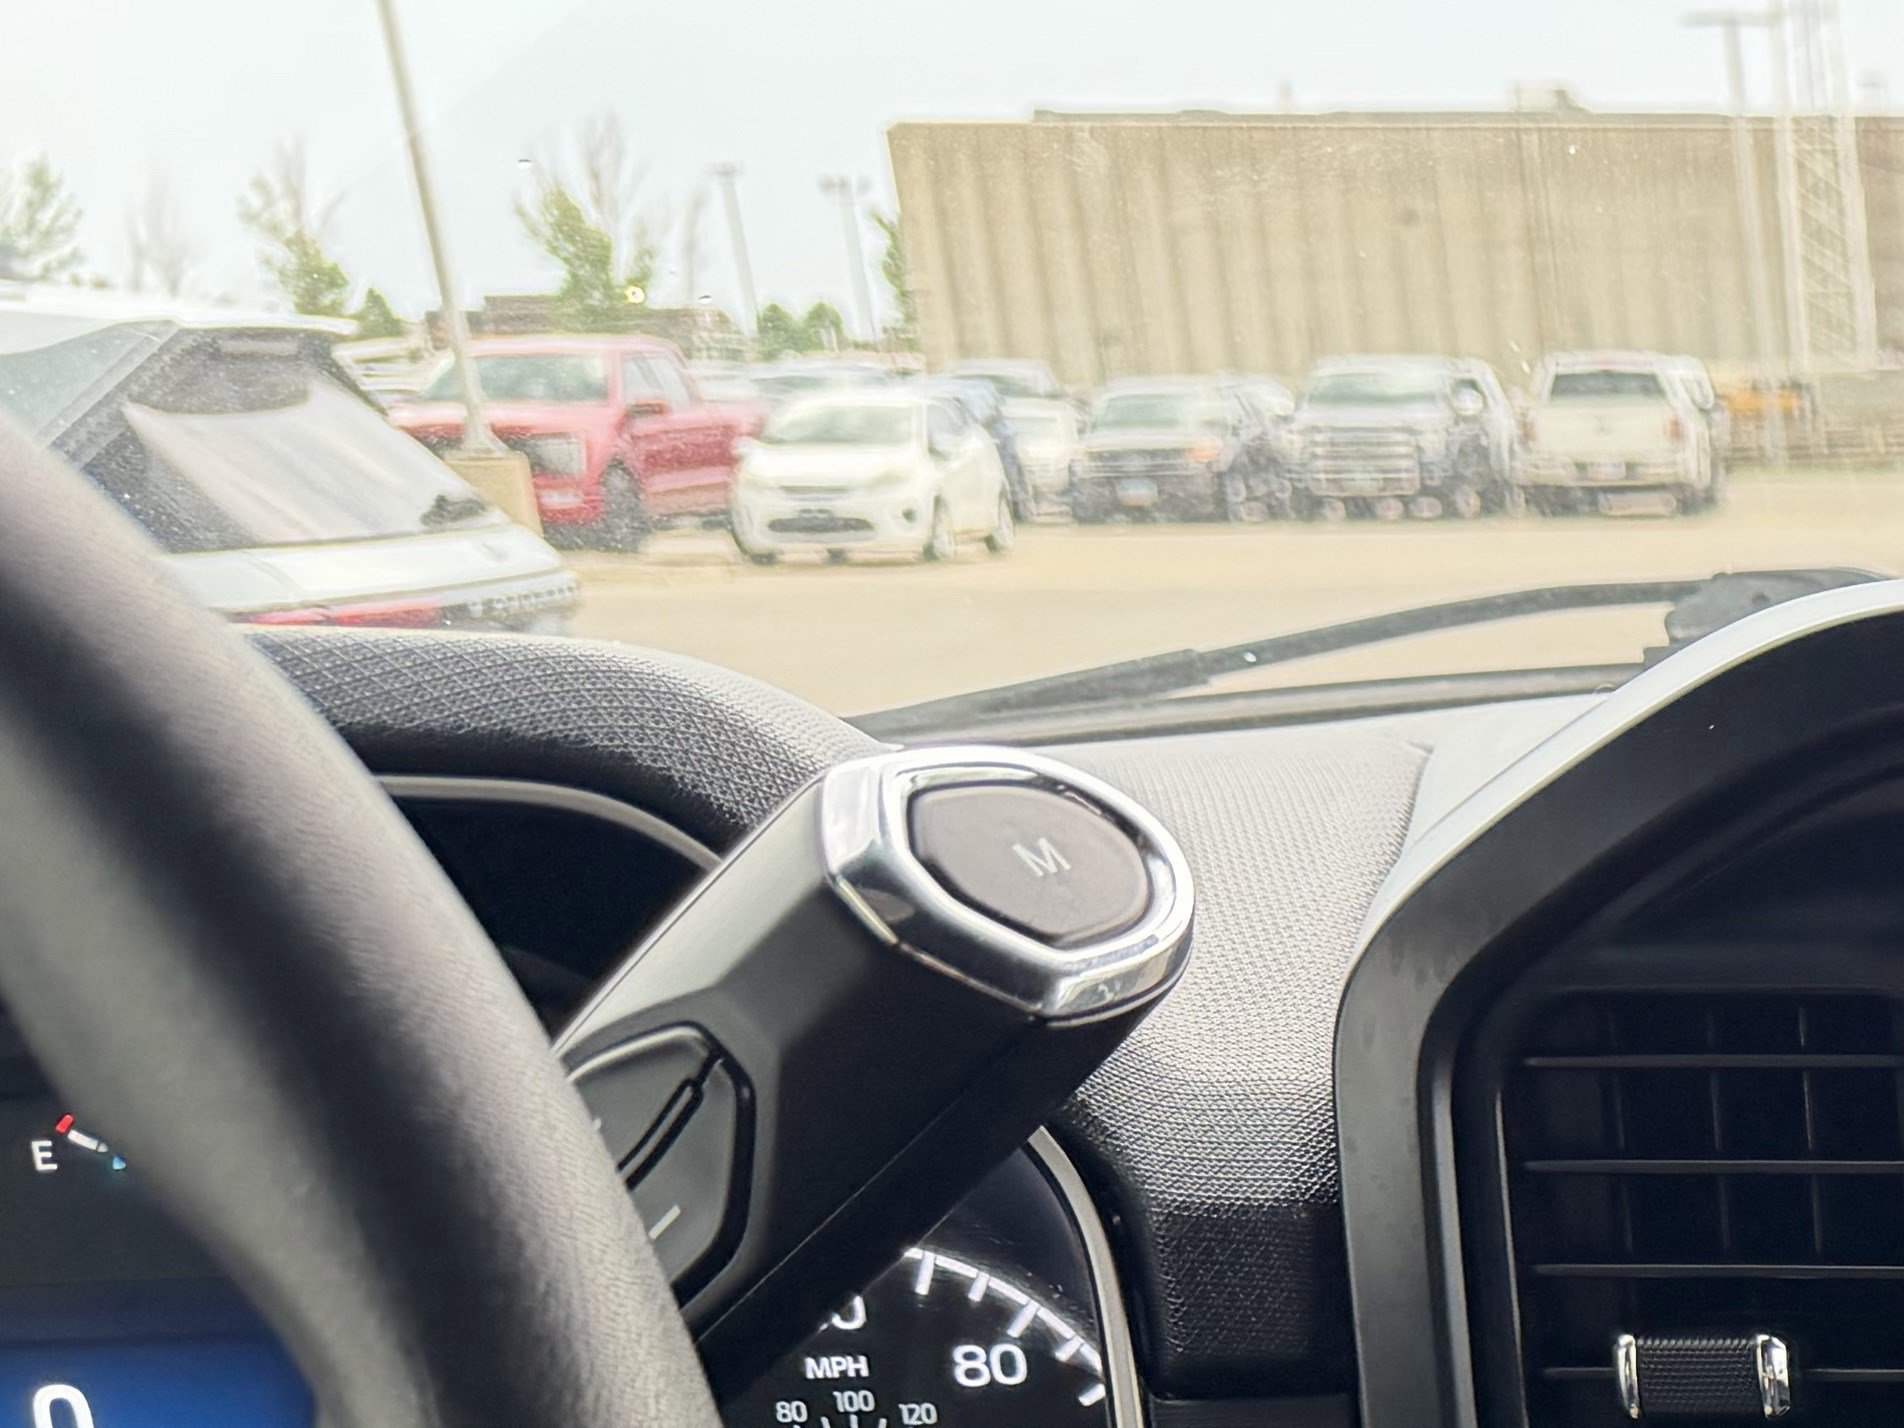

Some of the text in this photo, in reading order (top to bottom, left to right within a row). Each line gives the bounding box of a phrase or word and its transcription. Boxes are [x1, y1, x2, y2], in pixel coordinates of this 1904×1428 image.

[1011, 836, 1072, 877] M
[31, 1139, 58, 1172] E
[804, 1355, 869, 1380] MPH
[952, 1342, 1028, 1388] 80
[775, 1399, 808, 1424] 80
[832, 1389, 875, 1413] 100
[898, 1401, 938, 1426] 120
